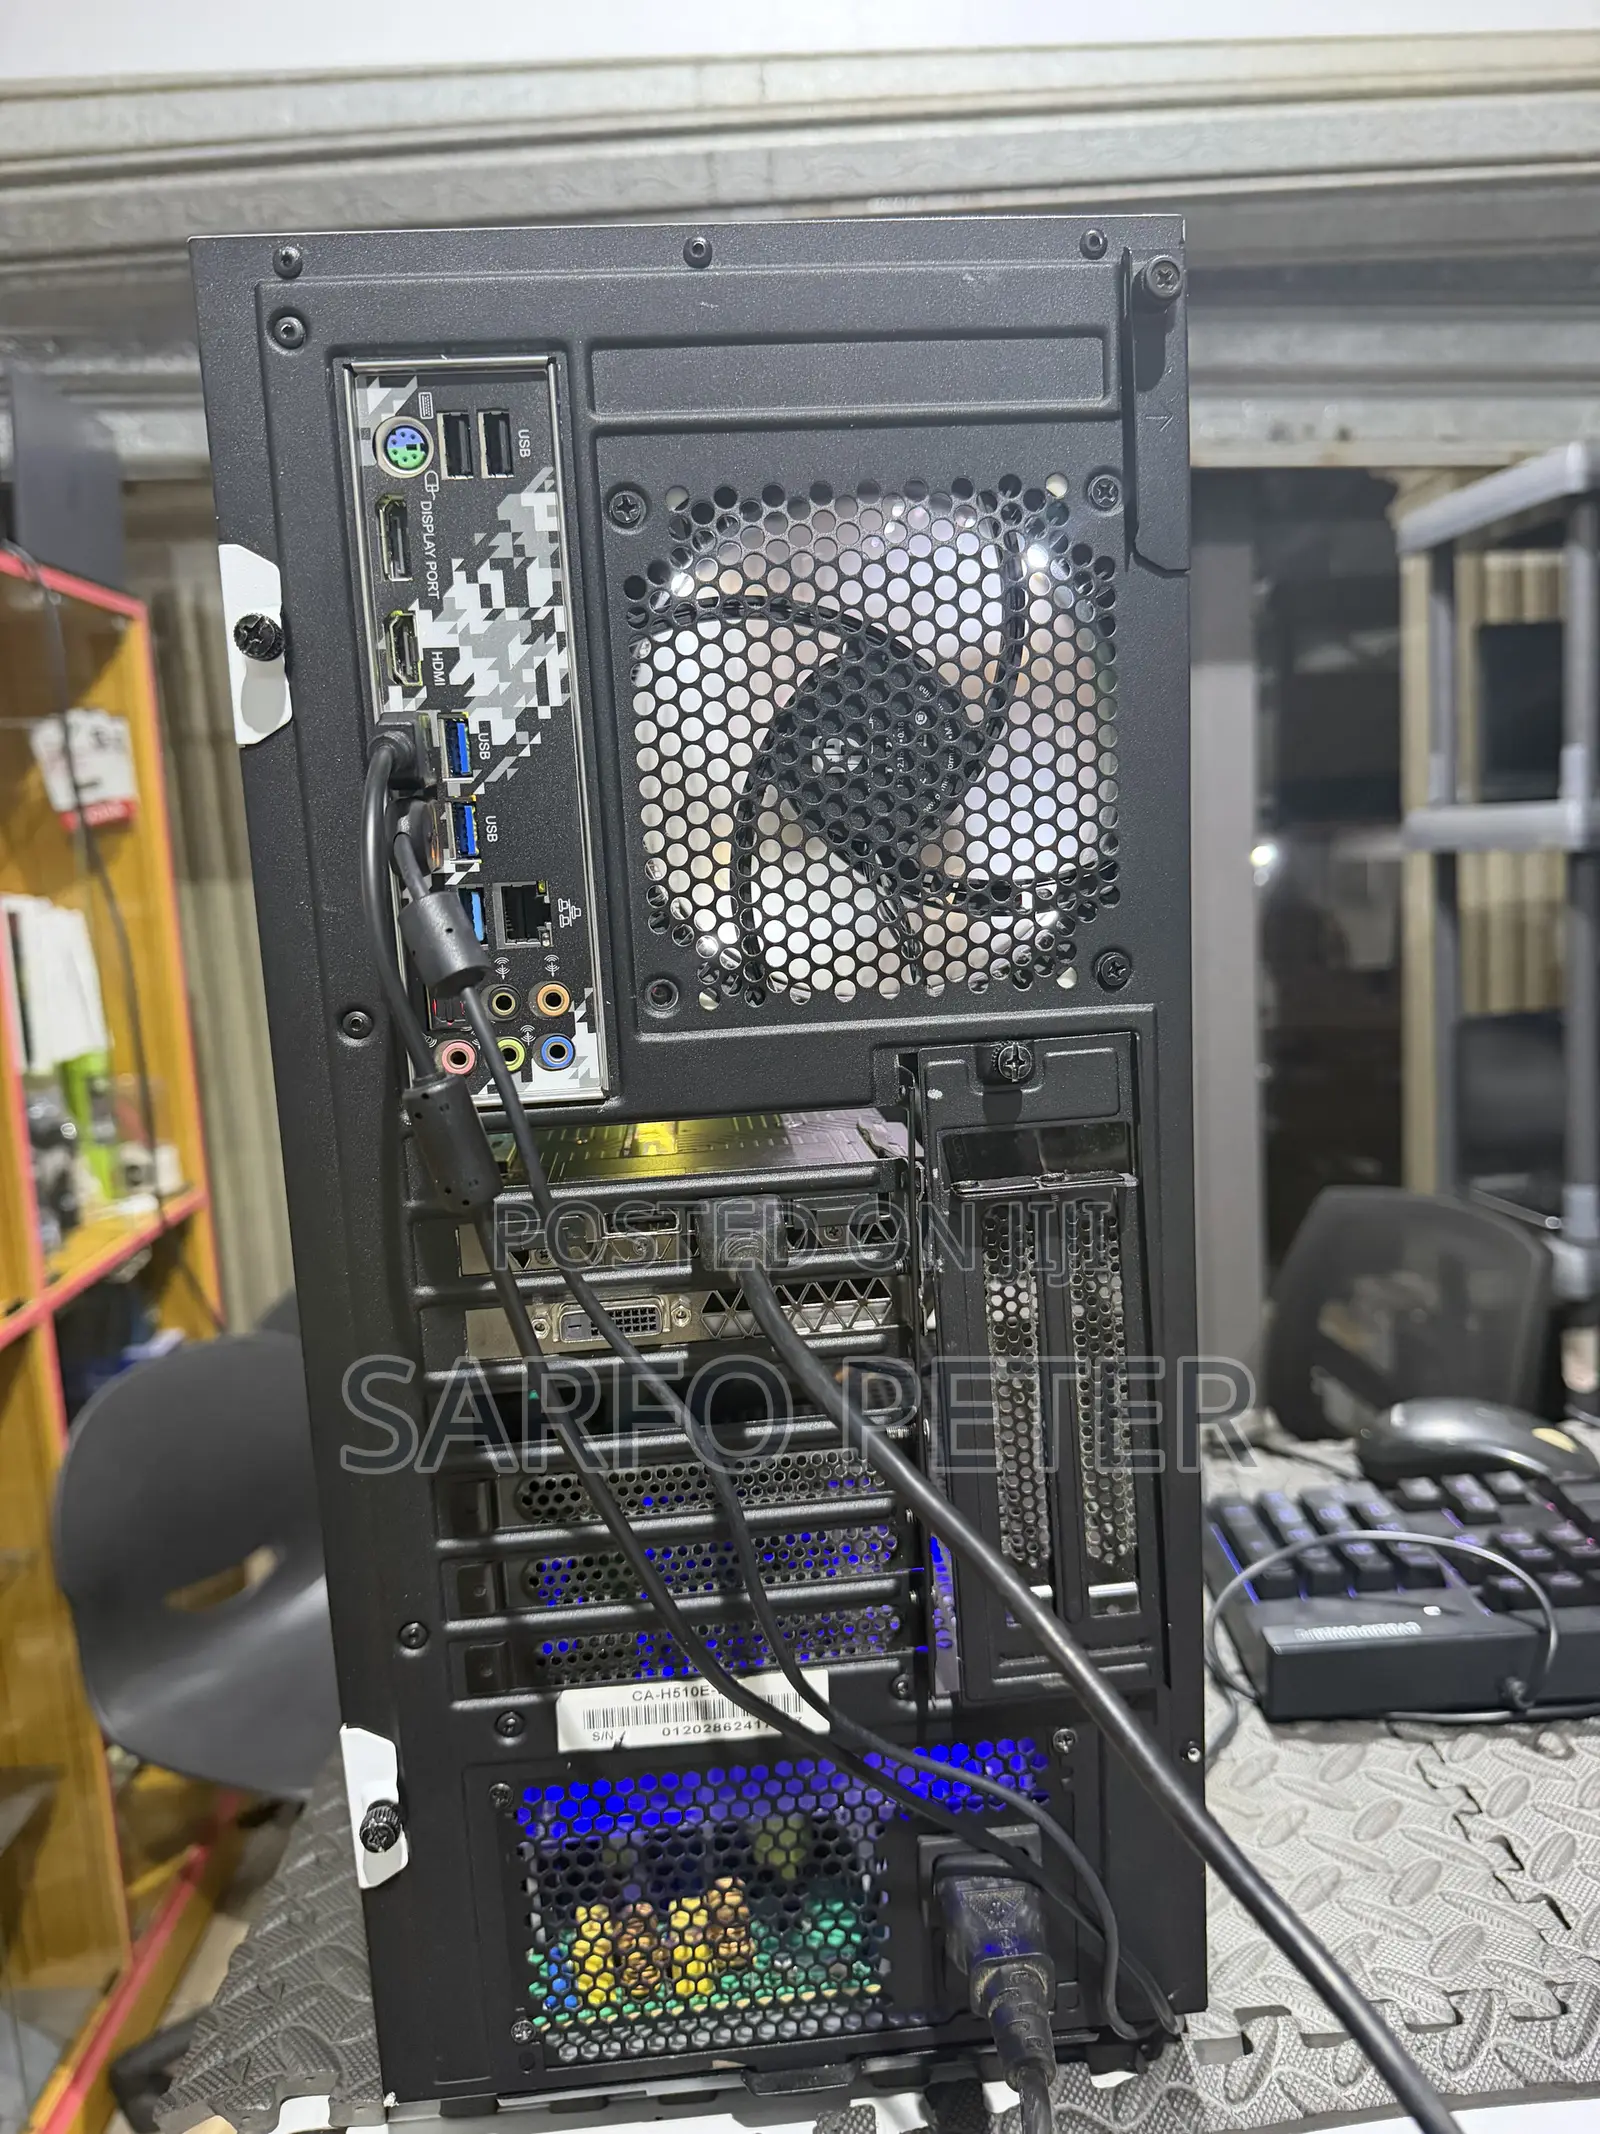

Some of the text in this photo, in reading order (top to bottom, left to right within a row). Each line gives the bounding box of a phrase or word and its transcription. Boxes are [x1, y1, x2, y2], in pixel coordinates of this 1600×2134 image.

[518, 429, 531, 458] USB
[420, 500, 440, 599] DISPLAY PORT
[431, 651, 446, 686] HDMI
[478, 732, 491, 760] USB
[485, 815, 498, 842] USB
[632, 1685, 721, 1702] CA-H510E-
[592, 1730, 614, 1742] S/N
